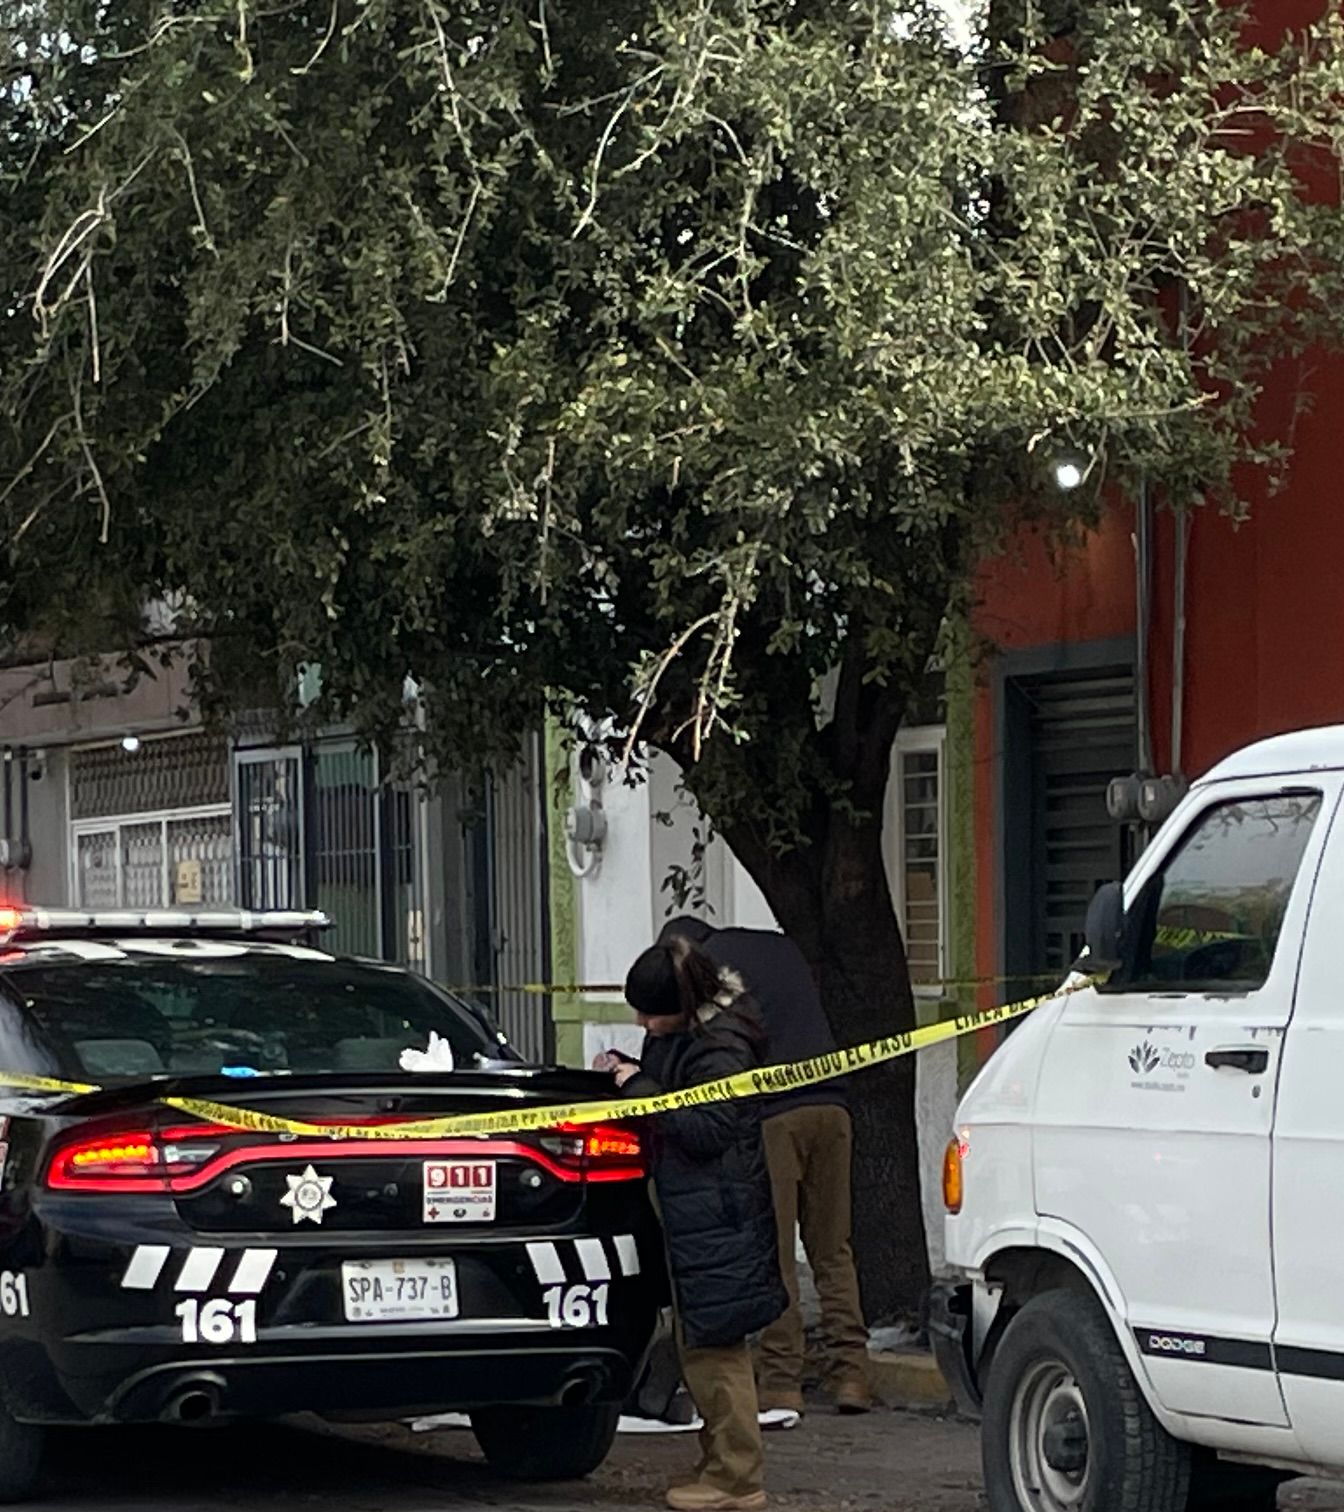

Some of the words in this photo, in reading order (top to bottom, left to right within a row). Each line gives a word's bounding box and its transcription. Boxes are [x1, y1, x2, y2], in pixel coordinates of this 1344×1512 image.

[751, 1052, 842, 1092] PROHIBIDO
[845, 1046, 867, 1067] EL
[869, 1032, 913, 1060] PASO
[429, 1166, 489, 1188] 911
[348, 1275, 452, 1303] SPA-737-B
[542, 1282, 610, 1328] 161
[175, 1298, 257, 1343] 161
[1149, 1335, 1205, 1354] DODGE
